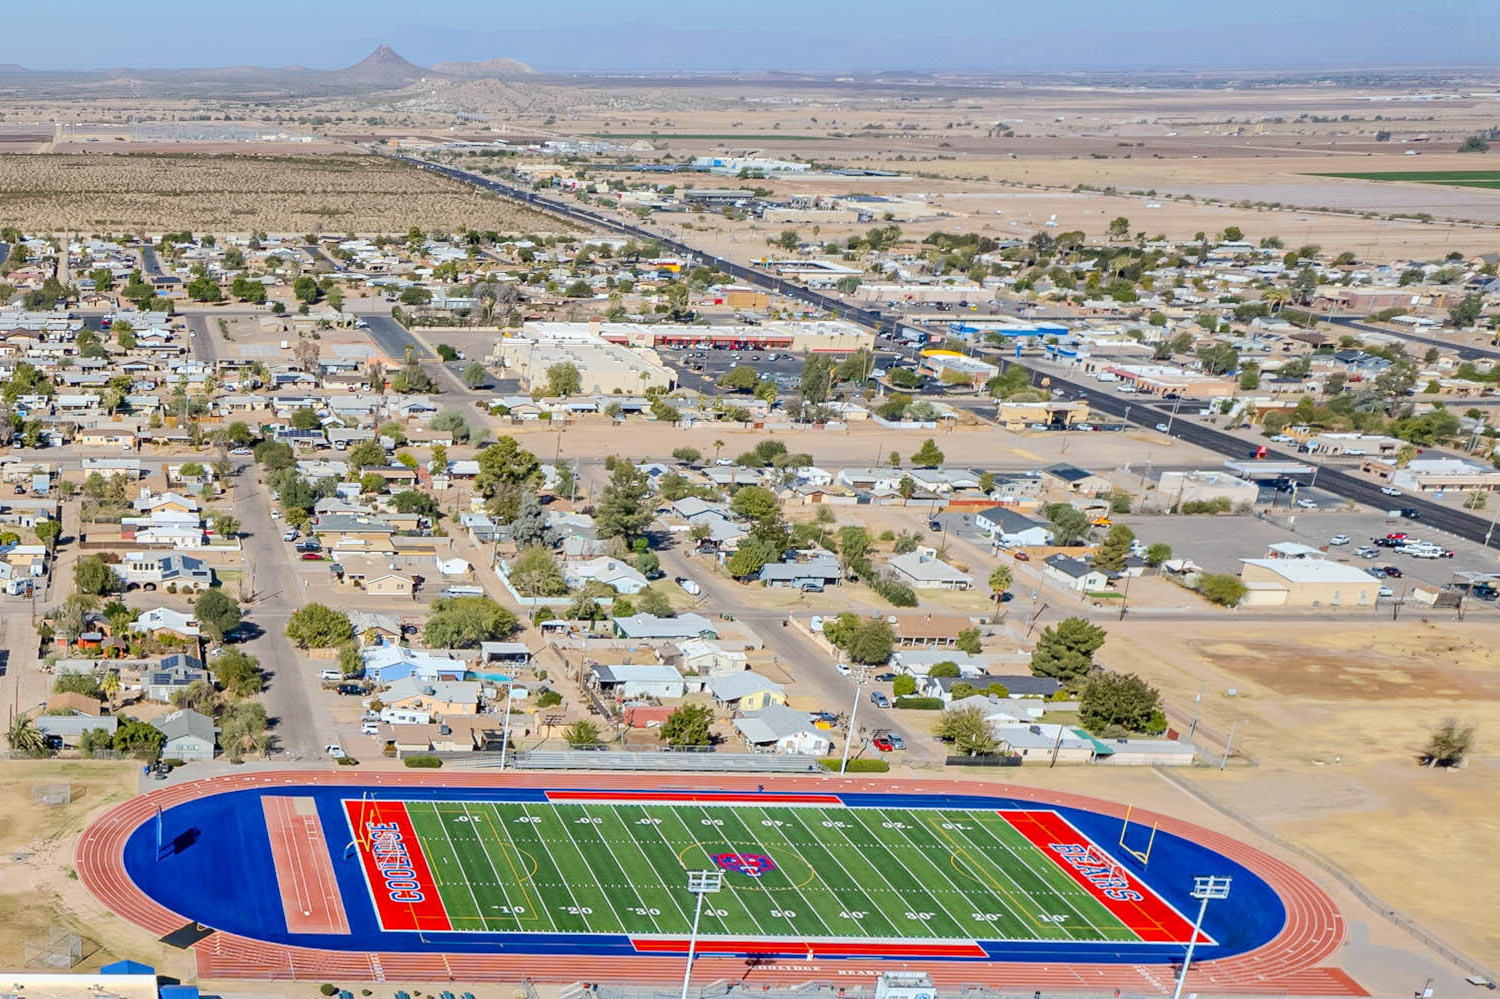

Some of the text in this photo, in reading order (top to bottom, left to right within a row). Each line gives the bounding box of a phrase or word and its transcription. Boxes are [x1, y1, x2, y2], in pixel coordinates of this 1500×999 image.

[366, 822, 425, 903] COOLIDGE
[1048, 843, 1144, 901] BEARS
[500, 906, 525, 914] 10
[567, 906, 593, 915] 20
[635, 907, 660, 916] 30
[704, 908, 729, 917] 40
[770, 909, 796, 918] 50
[839, 910, 864, 919] 40
[905, 911, 931, 920] 30
[972, 912, 998, 921] 20
[1038, 914, 1065, 922] 10
